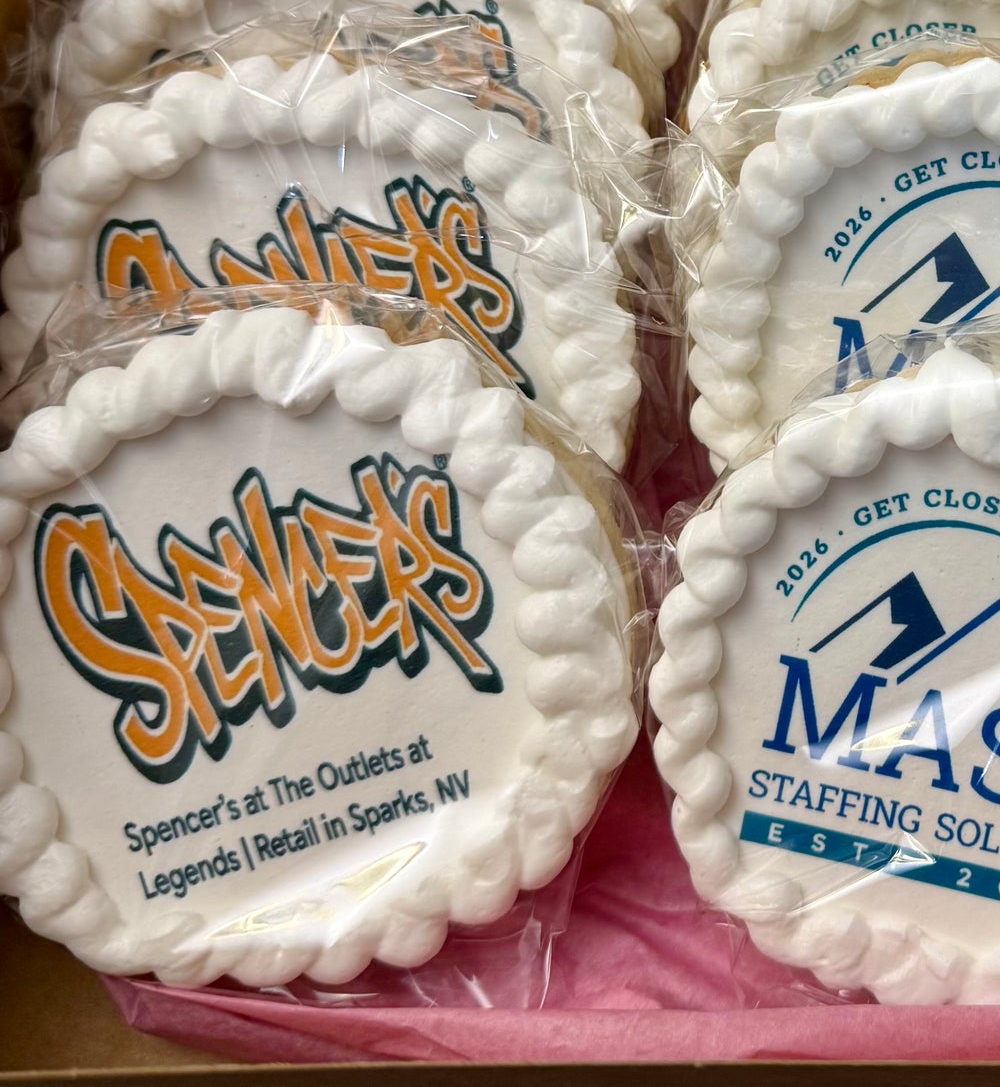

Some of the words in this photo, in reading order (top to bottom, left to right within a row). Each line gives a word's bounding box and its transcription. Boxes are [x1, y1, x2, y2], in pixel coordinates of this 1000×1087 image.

[824, 204, 873, 264] 2026
[894, 156, 948, 193] GET
[775, 537, 830, 598] 2026
[853, 492, 911, 528] GET
[124, 793, 242, 856] Spencer's
[243, 785, 270, 815] at
[267, 774, 316, 806] The
[317, 746, 405, 791] Outlets
[407, 734, 434, 764] at
[138, 845, 243, 900] Legends
[252, 816, 321, 862] Retail
[320, 813, 348, 841] in
[348, 789, 436, 837] Sparks,
[434, 768, 471, 805] NV
[748, 769, 923, 834] STAFFING
[766, 821, 870, 863] EST
